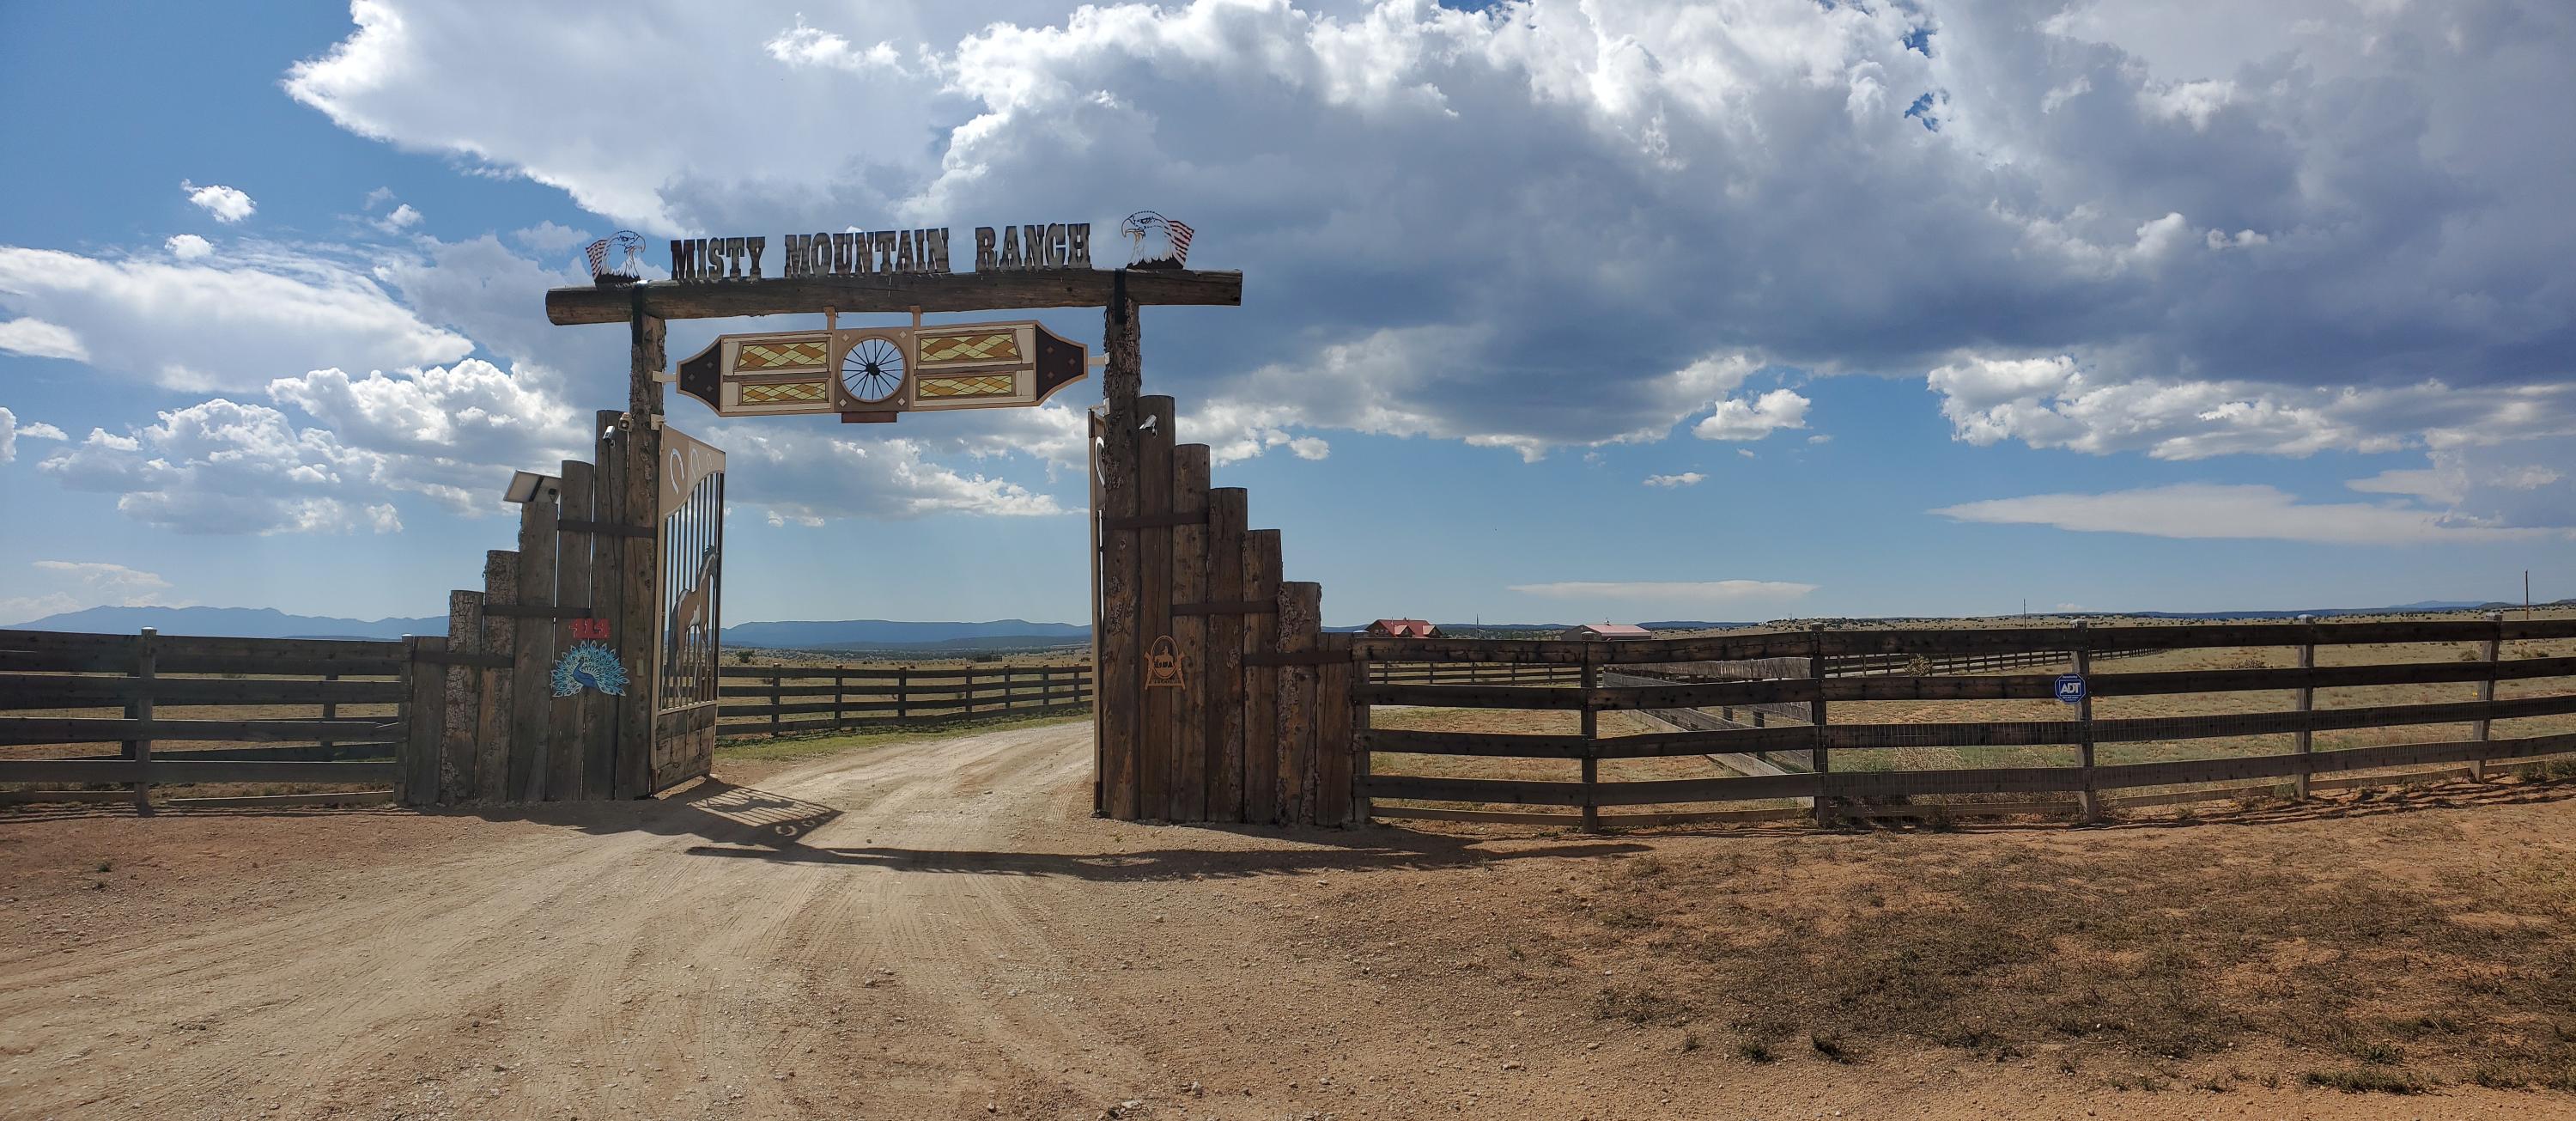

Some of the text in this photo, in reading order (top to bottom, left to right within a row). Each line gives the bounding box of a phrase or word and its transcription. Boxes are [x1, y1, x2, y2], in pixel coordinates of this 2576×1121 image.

[670, 222, 1091, 281] MISTY MOUNTAIN RANCH
[2061, 682, 2080, 694] ADT
